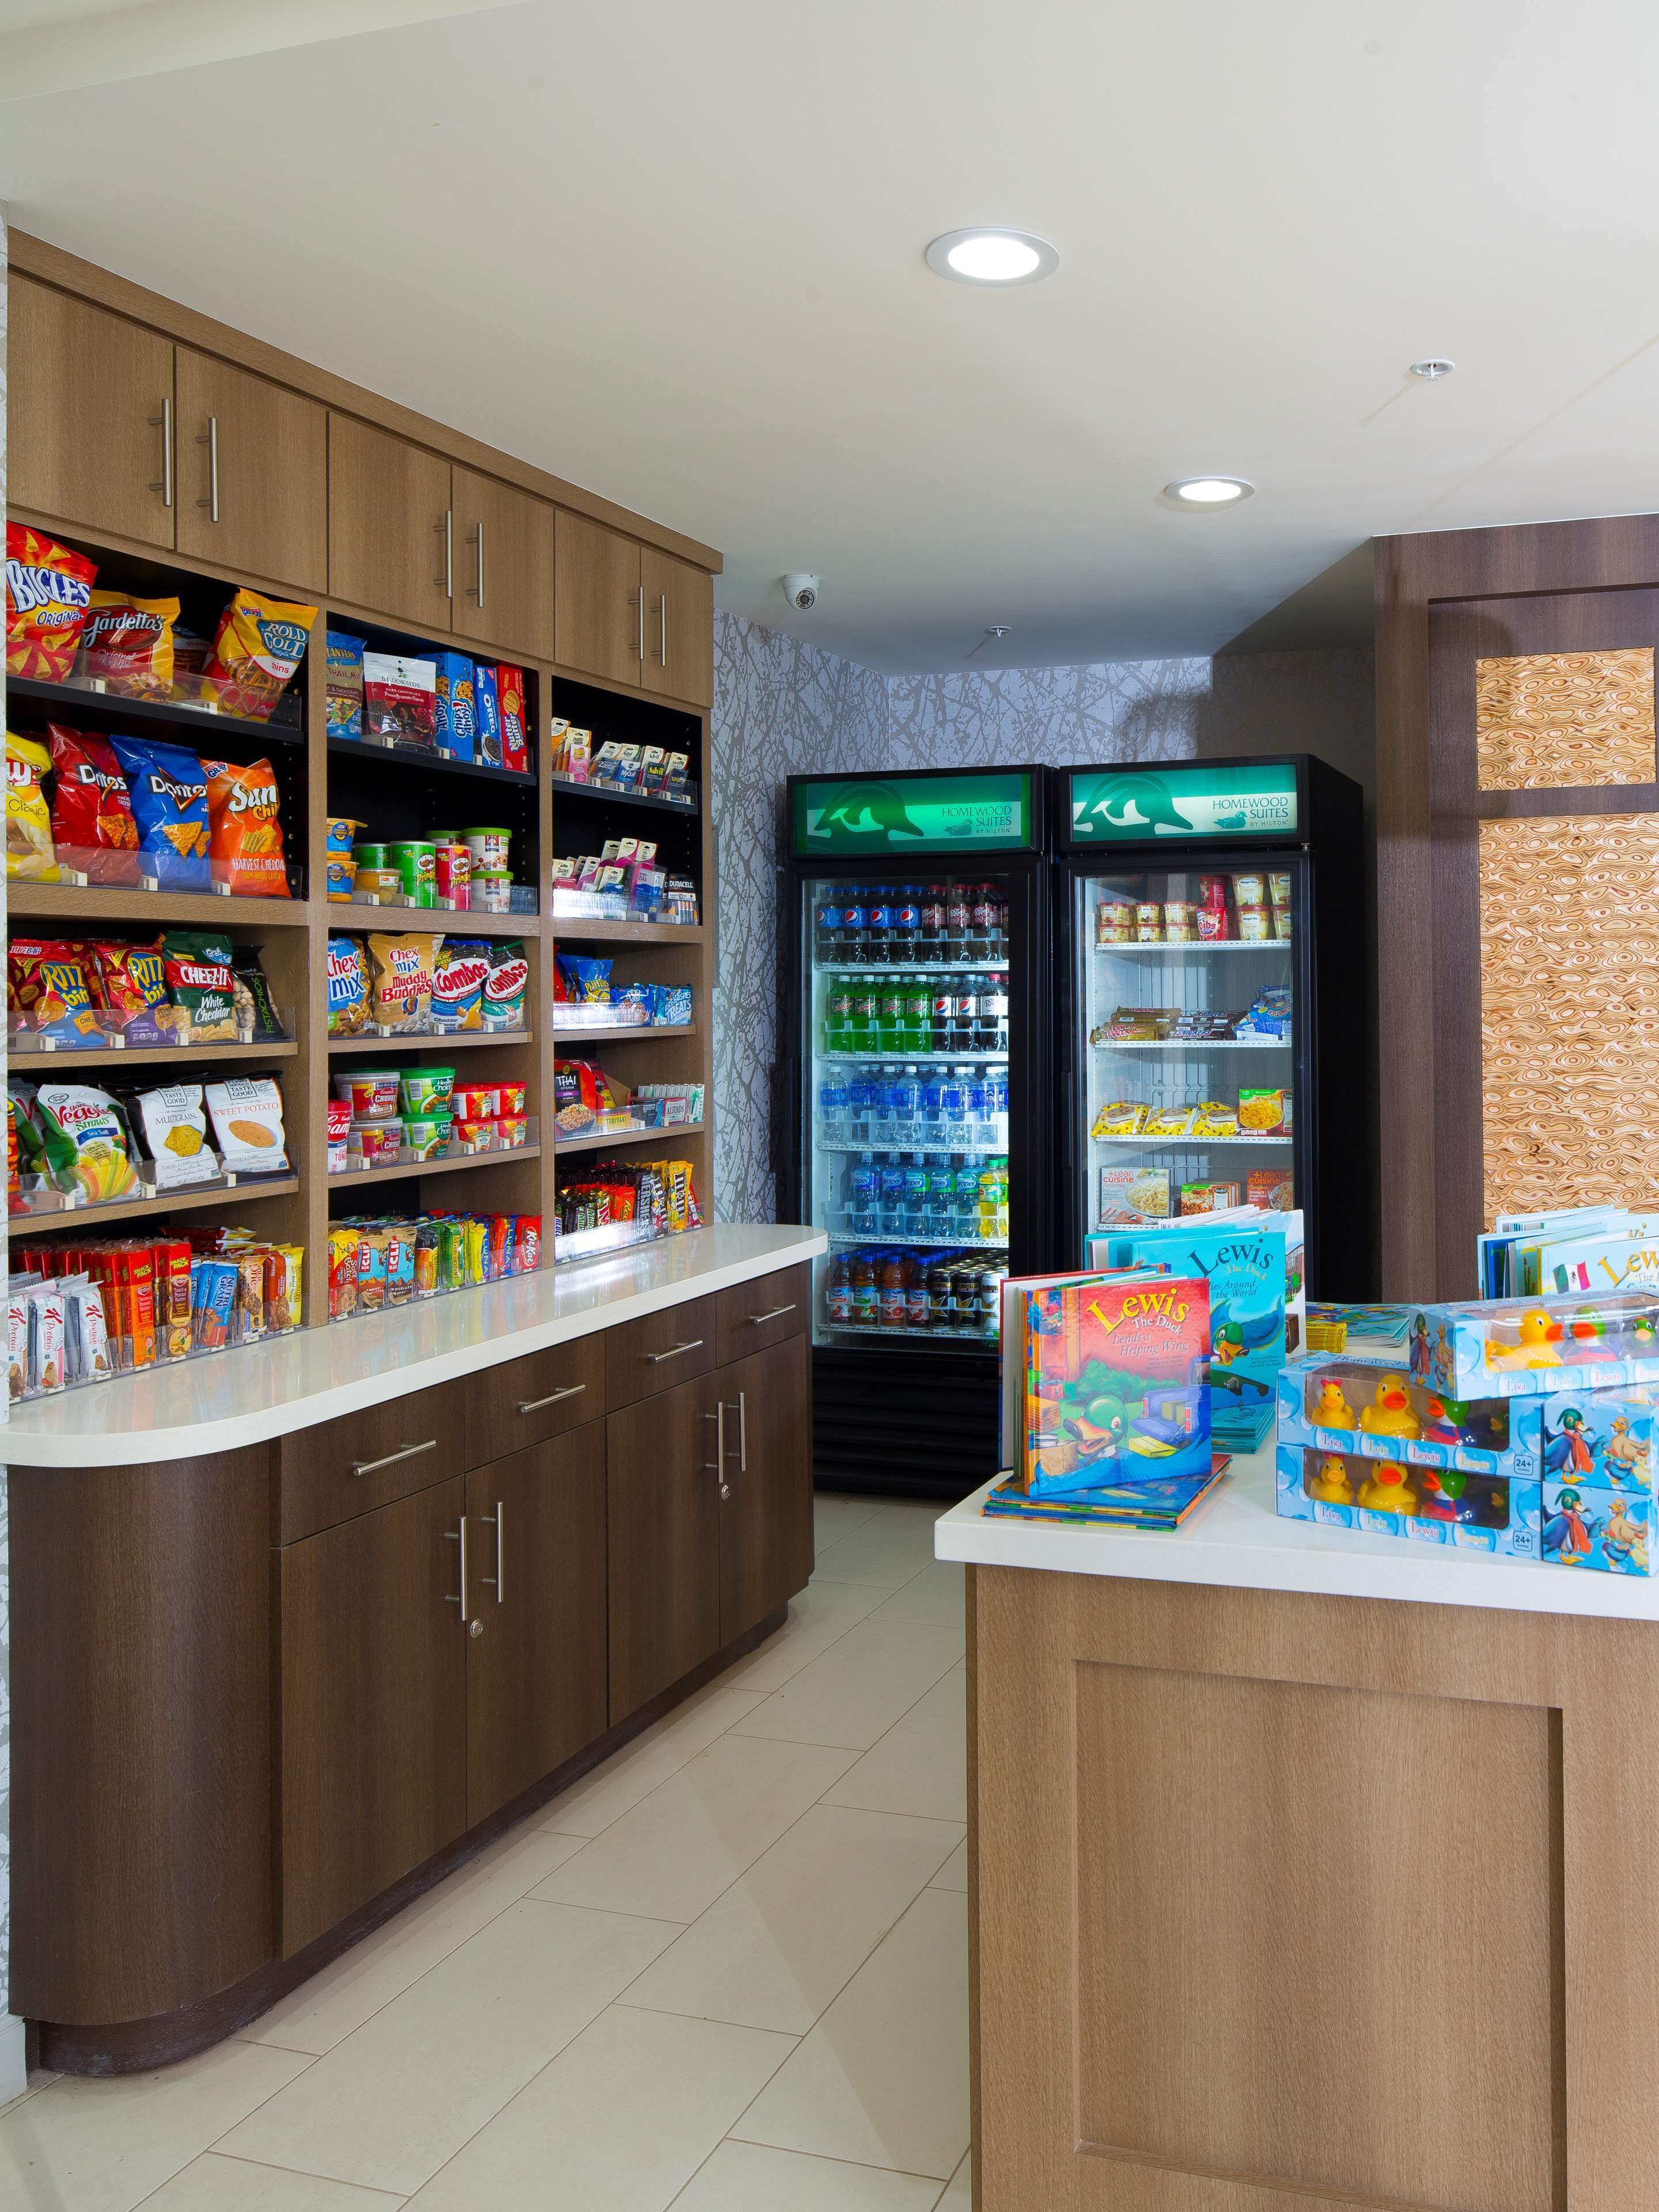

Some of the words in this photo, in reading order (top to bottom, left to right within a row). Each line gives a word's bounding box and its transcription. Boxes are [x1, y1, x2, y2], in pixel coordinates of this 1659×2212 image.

[6, 560, 90, 613] BUGLES
[266, 623, 306, 641] ROLD
[263, 632, 305, 658] GOLD
[327, 647, 355, 659] LANTERS
[272, 662, 289, 673] thins
[328, 668, 349, 679] TRAIL
[381, 676, 422, 688] BROOKSIDE
[483, 692, 495, 733] OREO
[504, 716, 518, 752] Nutter
[510, 711, 524, 747] Butter
[649, 767, 664, 775] Advil
[151, 776, 208, 798] Dorito
[228, 781, 277, 812] Sun
[1213, 796, 1289, 810] HOMEWOOD
[942, 805, 1012, 818] HOMEWOOD
[1249, 807, 1289, 819] SUITES
[976, 816, 1012, 827] SUITES
[232, 858, 259, 870] HARVEST
[1198, 920, 1217, 930] Dibs
[10, 945, 25, 954] BIG
[26, 946, 41, 955] BAG
[389, 948, 419, 962] Chex
[396, 957, 419, 972] mix
[40, 965, 85, 993] RITZ
[128, 956, 164, 992] RITZ
[180, 967, 228, 986] CHEEZ-IT
[392, 971, 427, 988] Muddy
[437, 963, 488, 993] Combos
[331, 972, 365, 999] mix
[381, 979, 432, 1003] Buddies
[585, 979, 609, 990] PLANTERS
[201, 995, 225, 1009] White
[252, 978, 274, 1033] PISTACHIOS
[195, 1008, 230, 1022] Cheddar
[665, 999, 691, 1023] TREATS
[556, 1075, 577, 1085] THAI
[48, 1105, 115, 1128] Veggie
[214, 1107, 242, 1118] SWEET
[245, 1102, 279, 1113] POTATO
[666, 1104, 684, 1115] ALTOIDS
[76, 1116, 109, 1131] Straws
[156, 1113, 196, 1125] MULTIGRAIN
[607, 1116, 627, 1125] TERIYAKI
[171, 1257, 186, 1266] SNACK
[362, 1244, 370, 1266] CLIF
[1187, 1238, 1274, 1278] Lewis
[134, 1264, 149, 1274] SNACK
[173, 1260, 188, 1270] PACK
[1225, 1264, 1241, 1275] The
[137, 1267, 151, 1279] PACK
[1224, 1278, 1256, 1289] Around
[215, 1276, 228, 1307] GRAIN
[224, 1276, 236, 1308] NUTRI
[1215, 1289, 1228, 1299] the
[1229, 1286, 1257, 1298] World
[9, 1308, 26, 1325] K
[44, 1308, 63, 1324] K
[86, 1305, 103, 1319] K
[1087, 1288, 1190, 1335] Lewis
[89, 1317, 97, 1346] Protein
[1132, 1317, 1153, 1330] The
[1156, 1317, 1183, 1336] Duck
[10, 1320, 19, 1353] Protein
[46, 1320, 56, 1351] Protein
[1112, 1332, 1142, 1345] Lends
[1119, 1340, 1159, 1357] Helping
[1161, 1339, 1189, 1354] Wing
[1595, 1370, 1622, 1384] Lewis
[1507, 1379, 1527, 1392] Lisa
[1323, 1434, 1342, 1448] Lisa
[1369, 1441, 1389, 1454] Lois
[1412, 1447, 1440, 1463] Lewis
[1516, 1459, 1532, 1468] 24+
[1322, 1506, 1341, 1521] Lisa
[1368, 1513, 1388, 1528] Lois
[1411, 1521, 1439, 1537] Lewis
[1515, 1535, 1531, 1544] 24+
